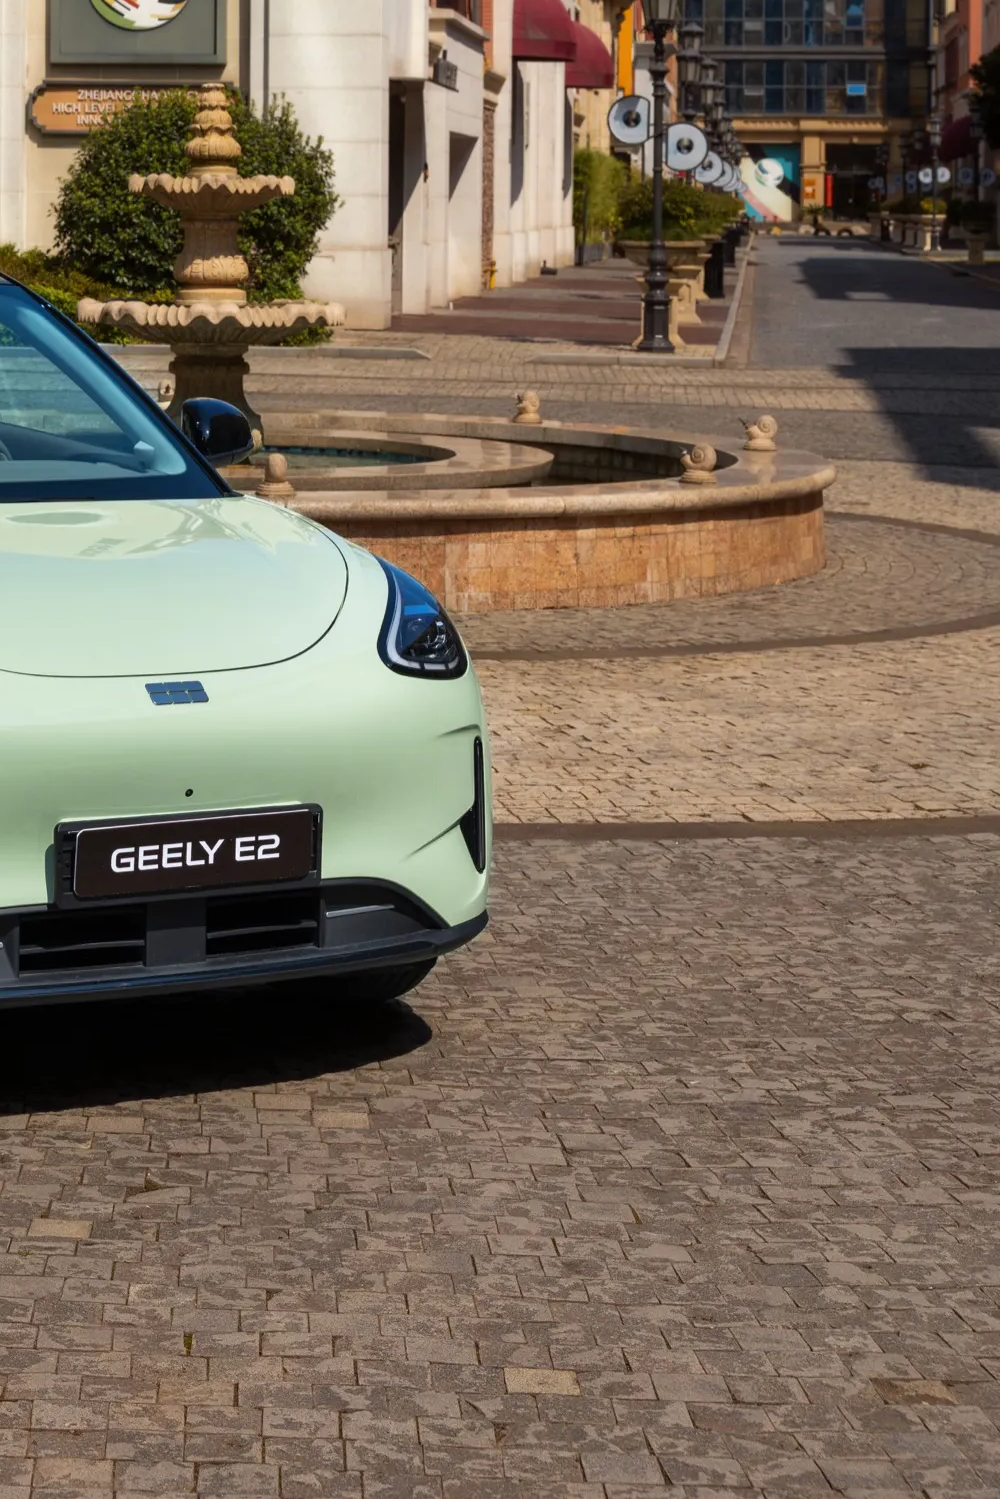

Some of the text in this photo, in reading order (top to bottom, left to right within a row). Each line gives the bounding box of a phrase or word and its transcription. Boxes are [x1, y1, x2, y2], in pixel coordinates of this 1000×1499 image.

[52, 102, 81, 113] HIGH
[110, 833, 281, 874] GEELY E2
